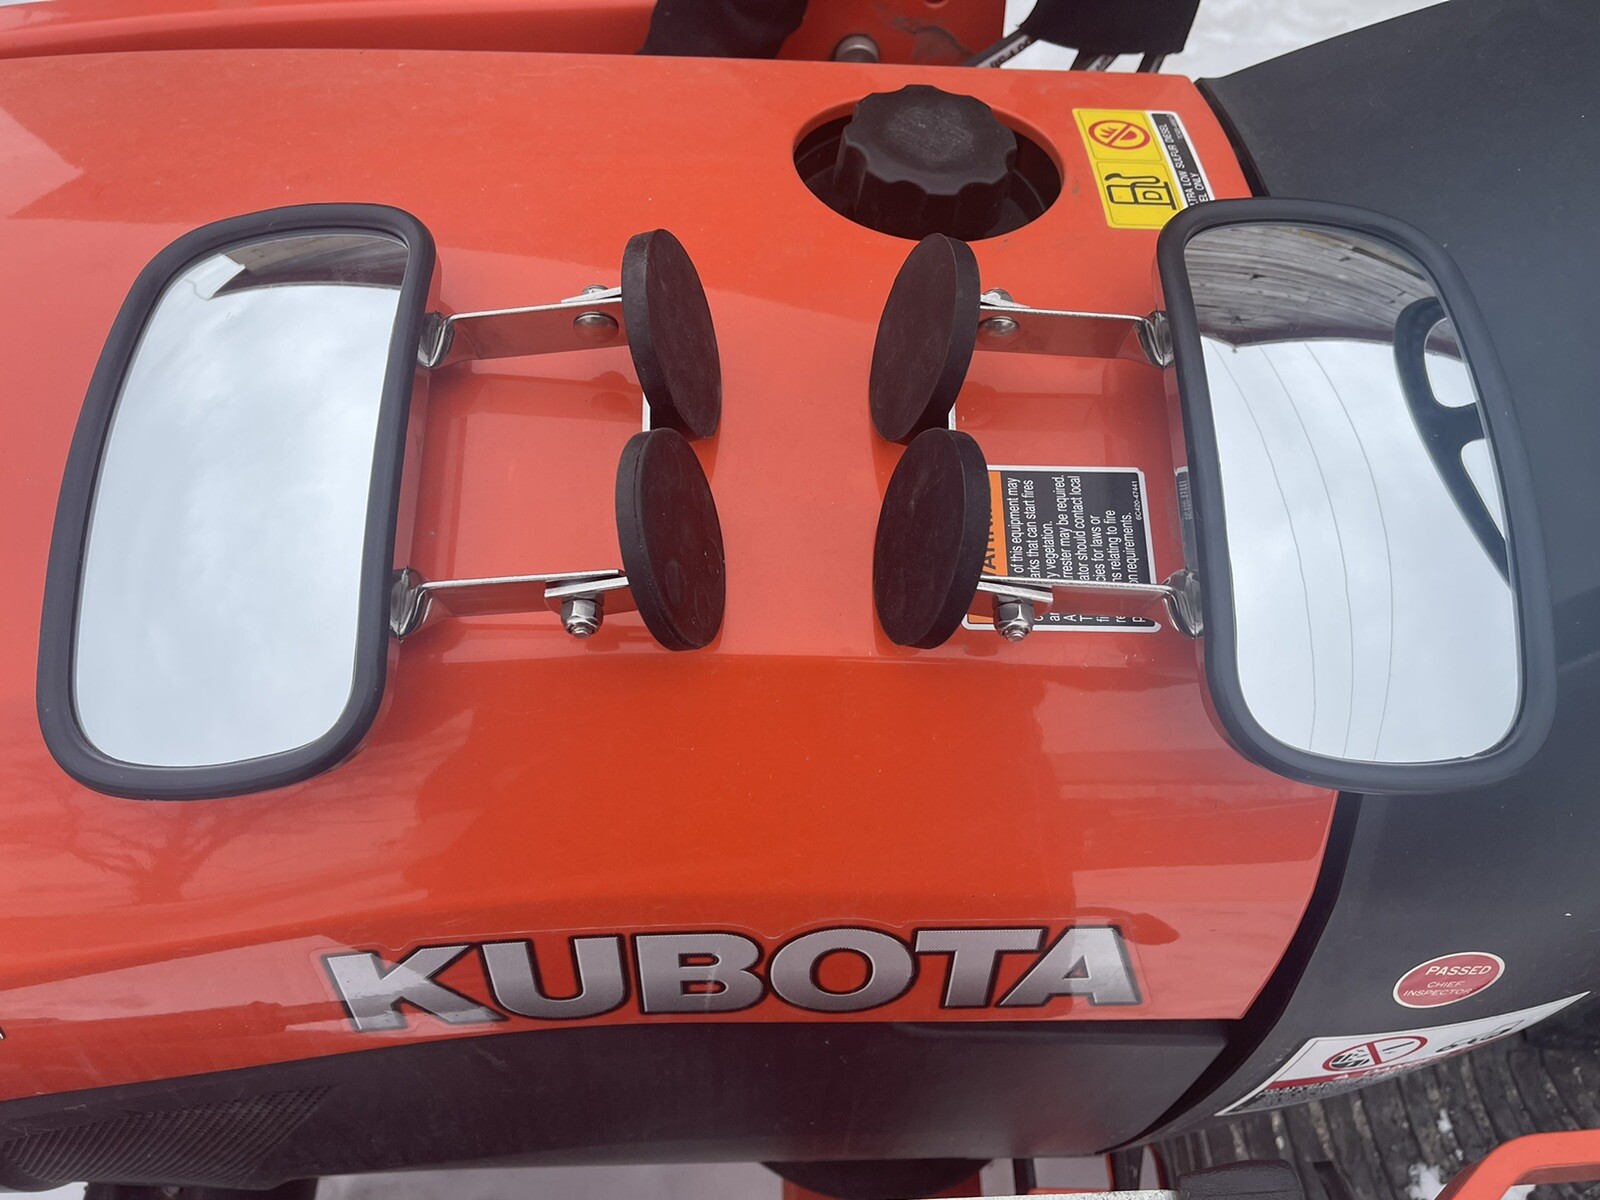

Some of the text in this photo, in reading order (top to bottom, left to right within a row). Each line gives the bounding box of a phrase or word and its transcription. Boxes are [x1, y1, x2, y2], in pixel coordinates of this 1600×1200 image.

[1159, 124, 1174, 144] DIESEL
[1167, 144, 1185, 169] SULFUR
[1178, 170, 1192, 187] LOW
[1189, 172, 1209, 203] EL ONLY
[1185, 188, 1198, 206] LTRA
[1053, 475, 1069, 511] required.
[1070, 476, 1081, 495] local
[1055, 513, 1067, 525] be
[1070, 497, 1085, 528] contact
[1089, 516, 1100, 524] or
[1104, 511, 1116, 523] fire
[1006, 478, 1024, 573] of this equipment may
[1022, 480, 1040, 578] arks that can start fires
[1105, 525, 1117, 535] to
[1042, 521, 1058, 569] vegetation.
[1057, 528, 1072, 546] may
[1074, 531, 1088, 560] should
[1088, 526, 1102, 547] laws
[1122, 513, 1139, 573] requirements.
[1059, 549, 1073, 578] rrester
[1089, 550, 1103, 561] for
[1106, 537, 1123, 570] relating
[323, 924, 1143, 1033] KUBOTA
[1425, 965, 1492, 976] PASSED
[1403, 988, 1473, 997] INSPECTOR
